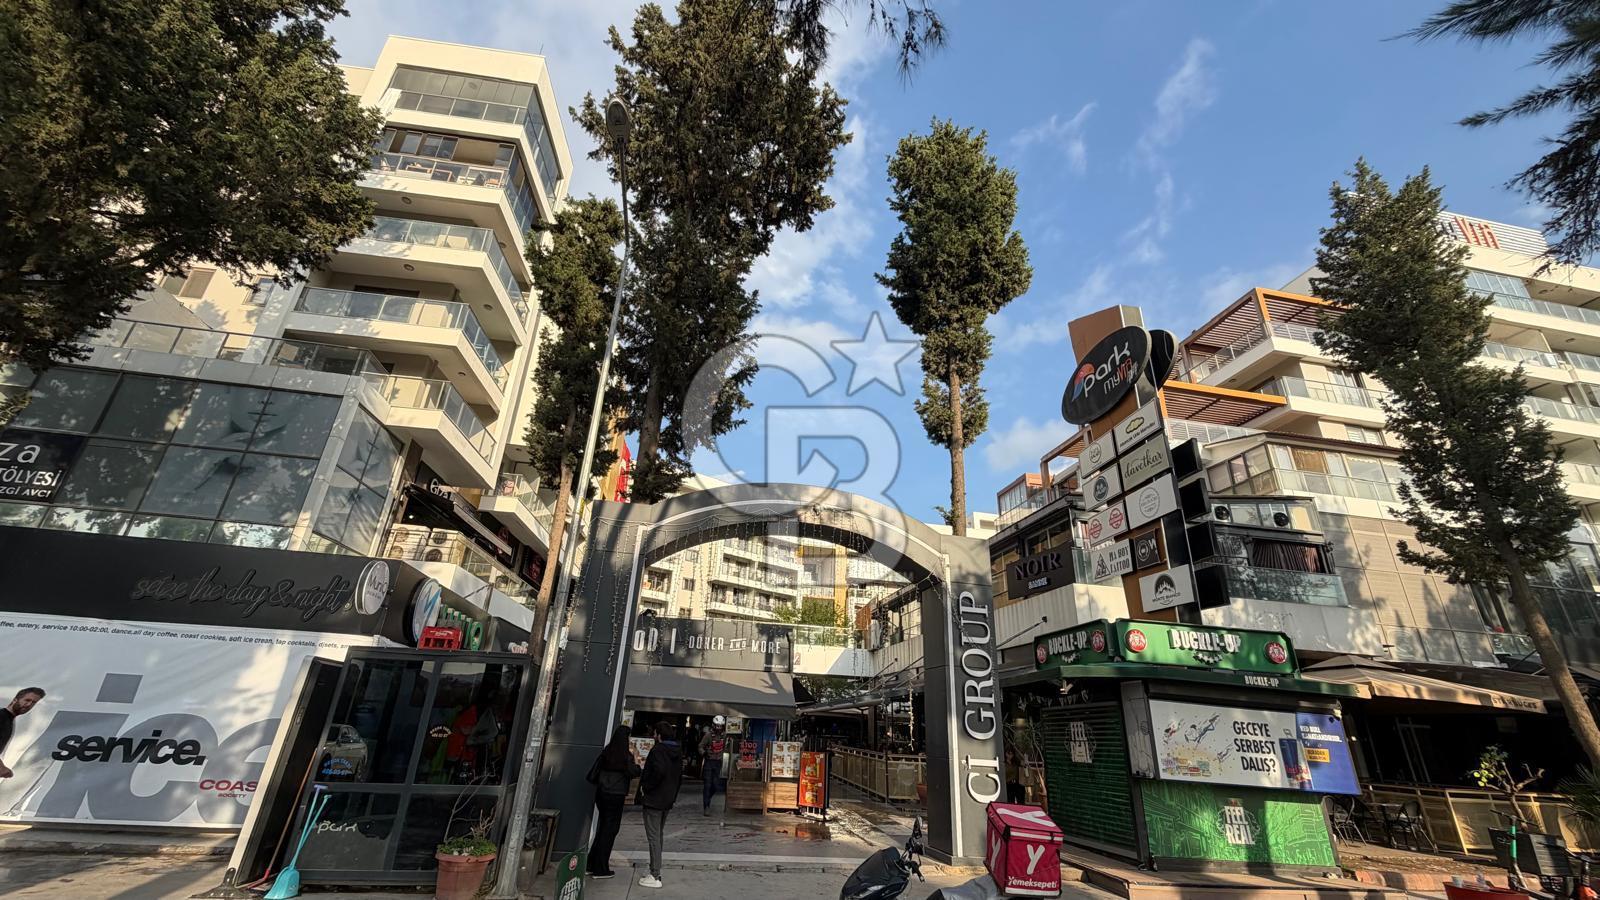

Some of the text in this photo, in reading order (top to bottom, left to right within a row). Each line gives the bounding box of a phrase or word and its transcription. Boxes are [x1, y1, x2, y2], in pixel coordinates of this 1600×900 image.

[1083, 340, 1131, 398] park
[1015, 552, 1062, 580] NOIR
[1110, 558, 1130, 573] TATTOO
[180, 632, 199, 640] coast
[229, 635, 242, 643] soft
[751, 640, 781, 654] MORE
[1048, 631, 1088, 656] BUCKLE-UP
[1169, 628, 1241, 653] BUCKLE-UP
[958, 590, 997, 741] GROUP
[1244, 675, 1280, 687] BUCKLE-UP
[1233, 720, 1271, 738] GECEYE
[52, 730, 208, 766] service.
[1234, 738, 1276, 755] SERBEST
[1240, 756, 1277, 776] DALIŞ?
[1224, 806, 1248, 824] FEEL
[1225, 824, 1256, 845] REAL
[1008, 876, 1058, 889] Yemeksepeti
